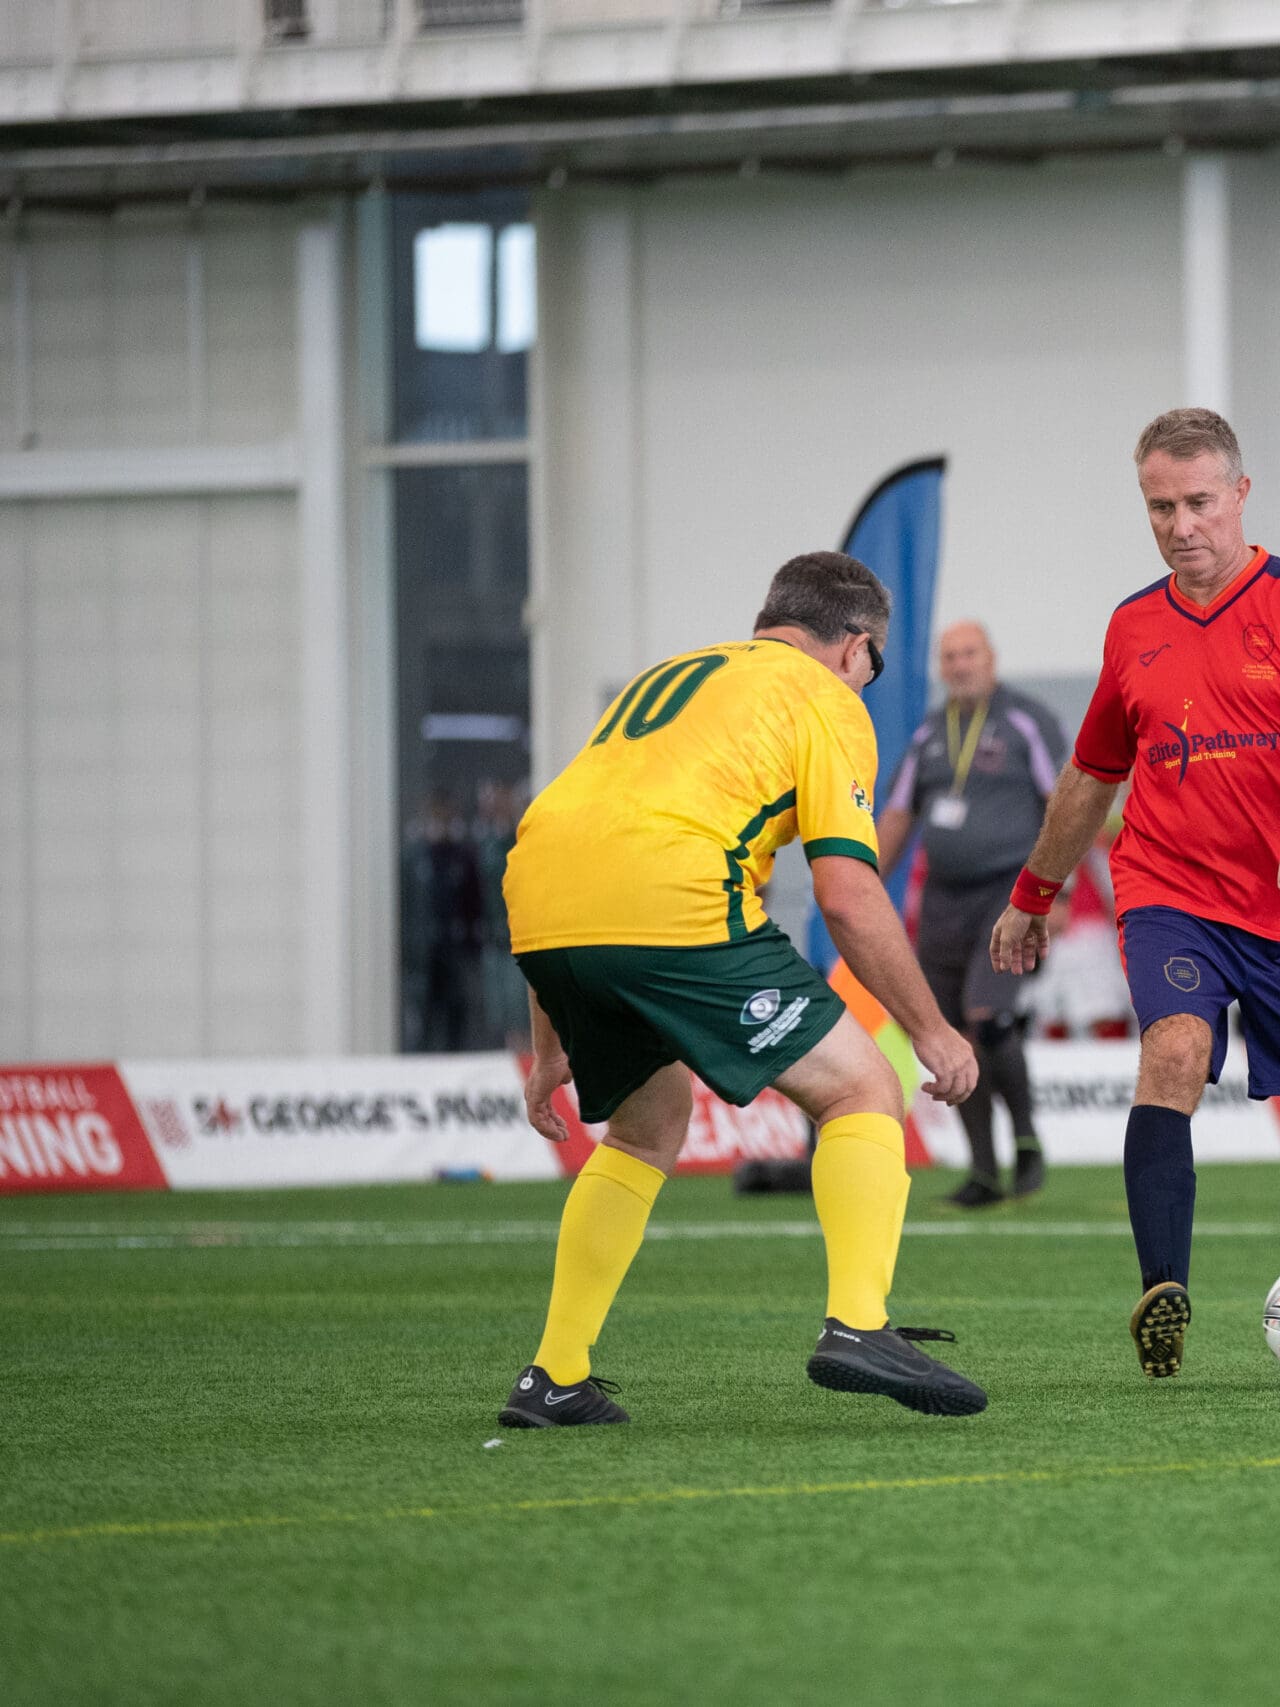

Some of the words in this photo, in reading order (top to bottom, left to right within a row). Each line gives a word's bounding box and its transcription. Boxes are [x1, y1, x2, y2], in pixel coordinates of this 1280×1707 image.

[590, 653, 728, 748] 10
[1147, 740, 1182, 766] Elite
[1203, 749, 1237, 761] Training
